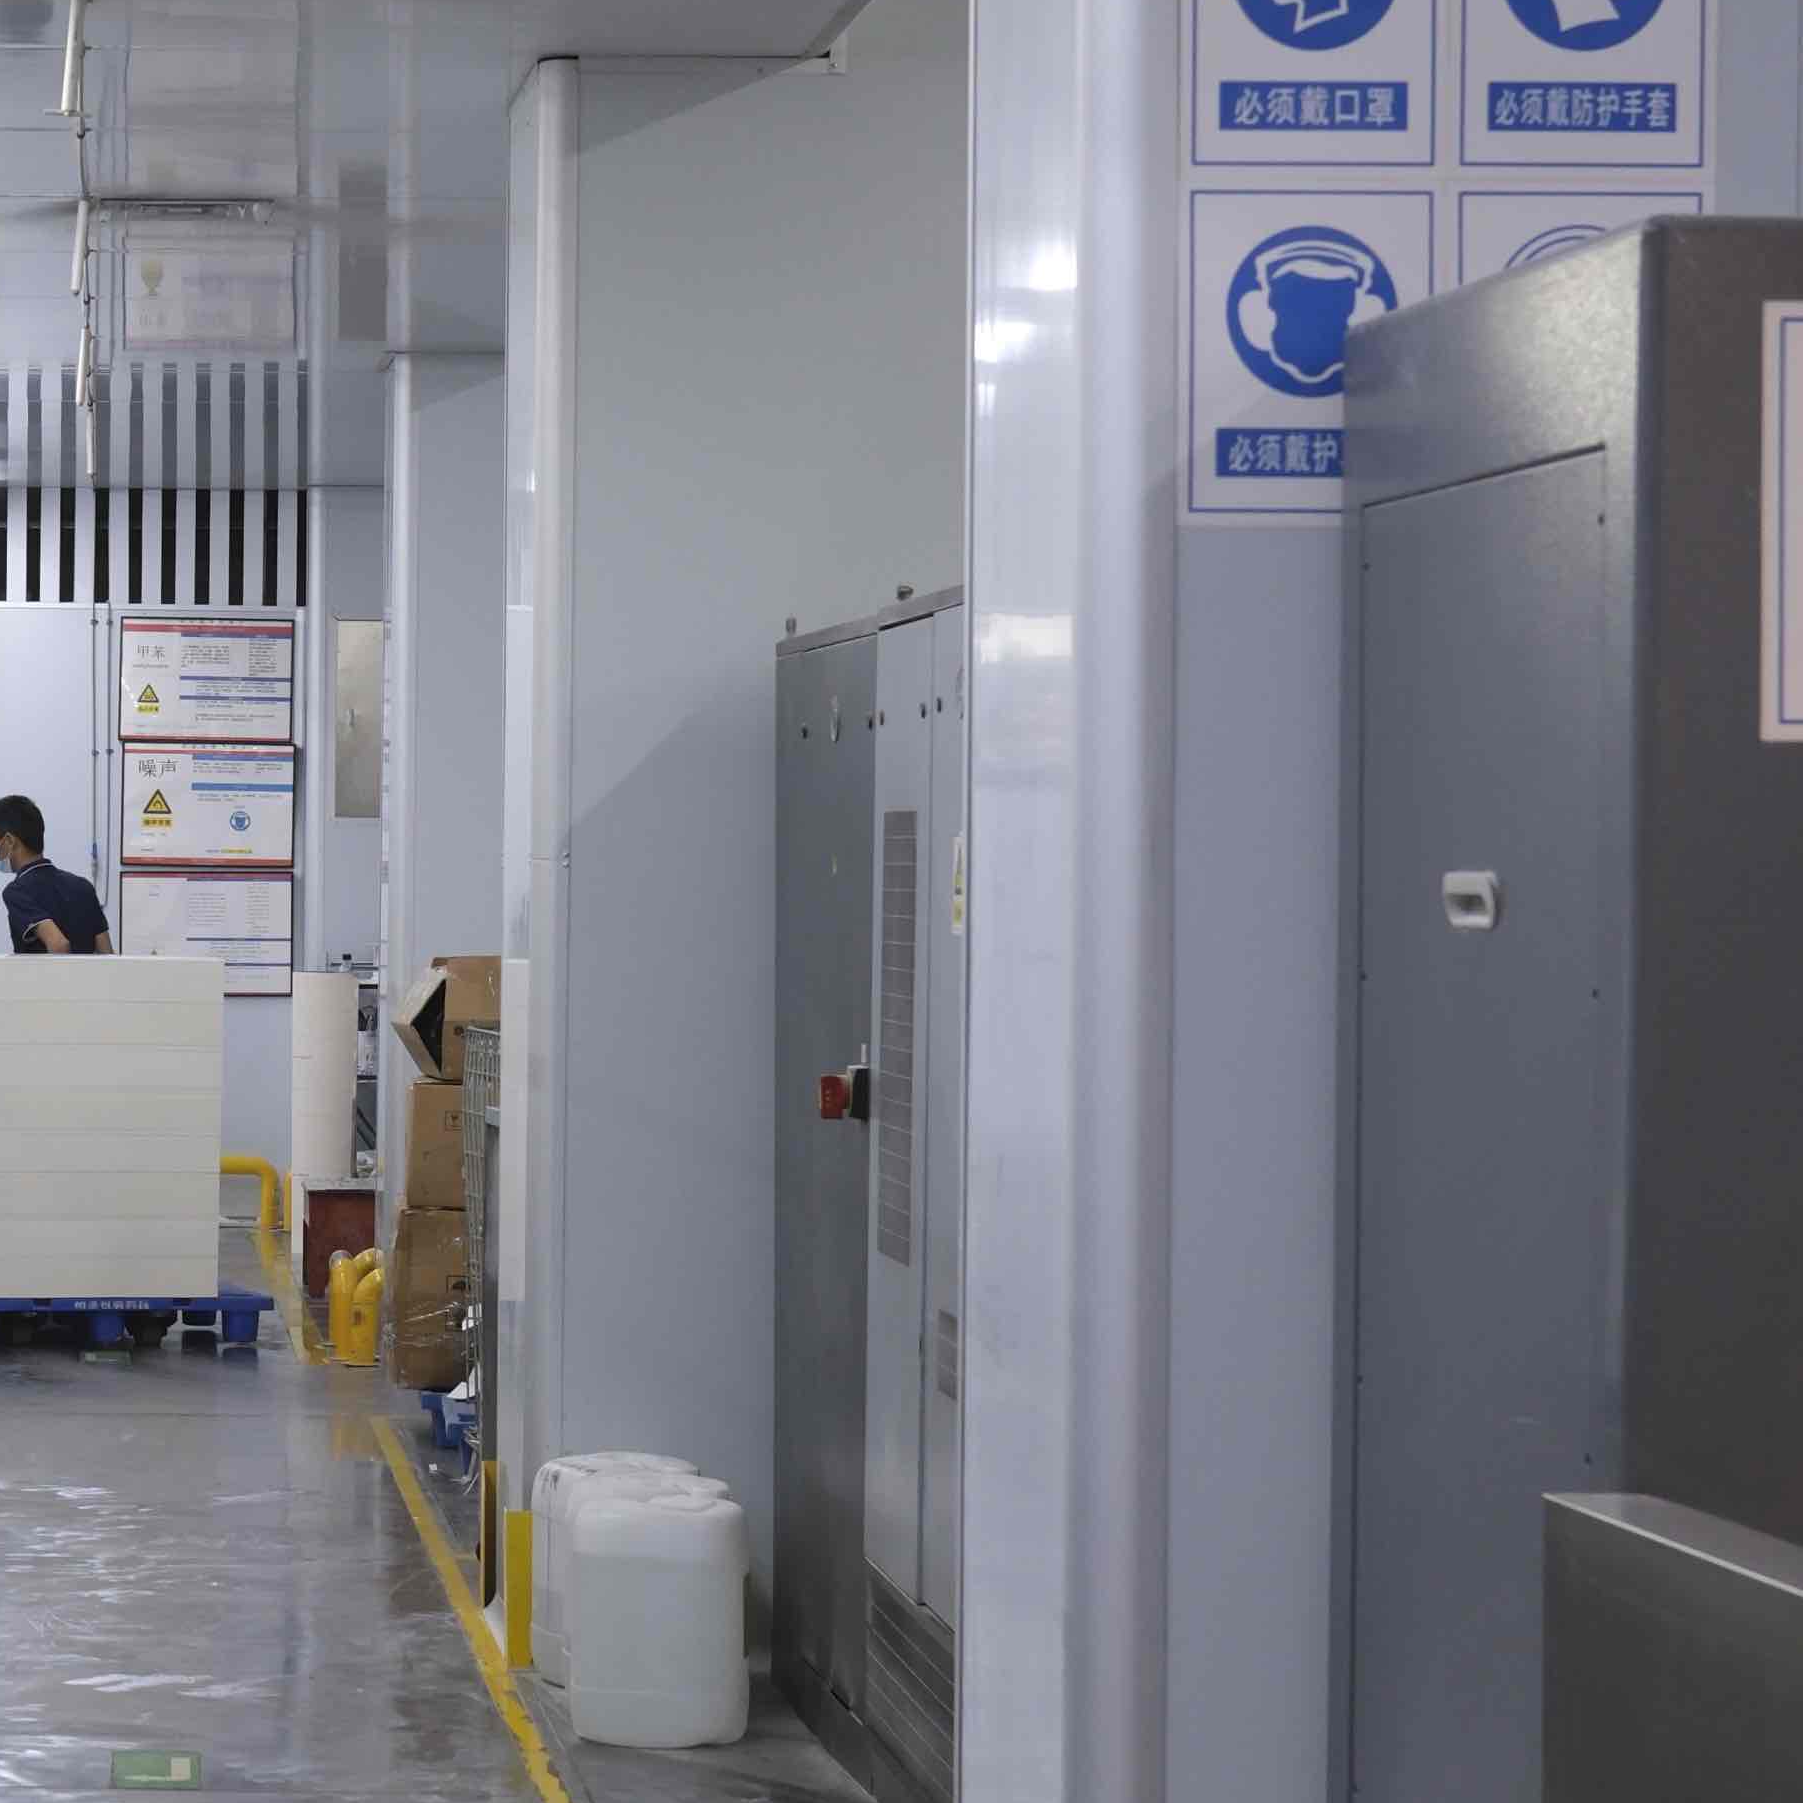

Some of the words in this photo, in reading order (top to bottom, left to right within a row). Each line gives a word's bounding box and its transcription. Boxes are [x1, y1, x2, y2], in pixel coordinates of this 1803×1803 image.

[1233, 85, 1396, 125] 必须戴口罩
[1494, 86, 1670, 128] 必须戴防护手套
[1228, 433, 1341, 473] 必须戴护
[137, 757, 181, 778] 噪声
